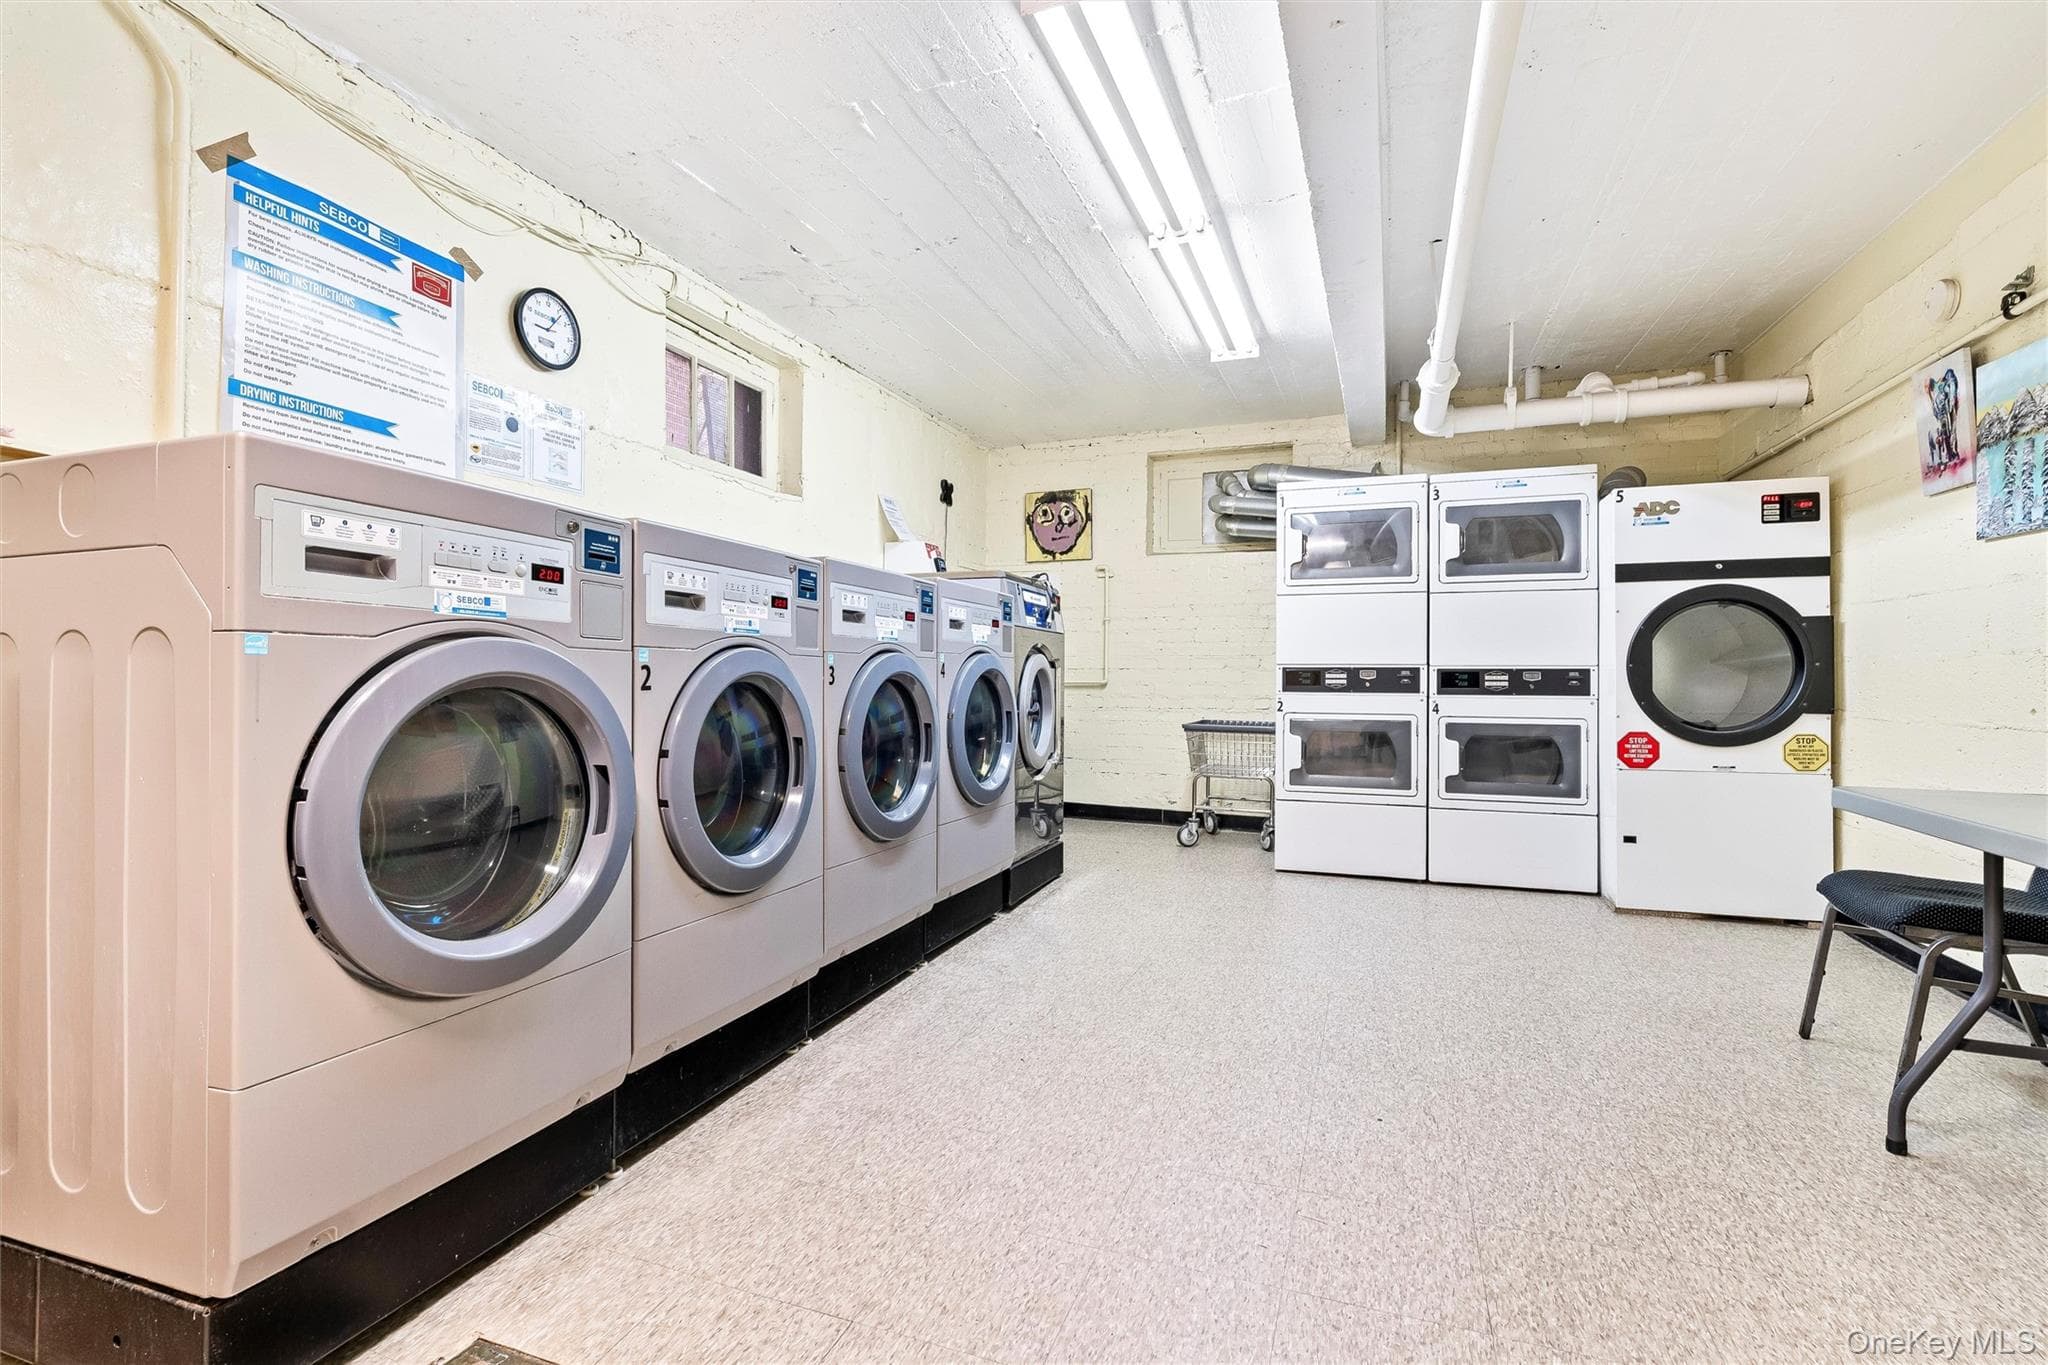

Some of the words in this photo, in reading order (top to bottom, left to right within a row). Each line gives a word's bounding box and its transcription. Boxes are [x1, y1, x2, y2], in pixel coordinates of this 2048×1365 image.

[245, 190, 288, 220] HELPFUL
[290, 210, 319, 234] HINTS
[319, 199, 367, 234] SEBCO
[245, 256, 289, 284] WASHING
[292, 274, 355, 309] INSTRUCTIONS
[472, 380, 500, 398] SEBCO
[240, 383, 276, 404] DRYING
[278, 393, 343, 422] INSTRUCTIONS
[1280, 496, 1285, 507] 1
[1433, 490, 1440, 501] 3
[1615, 489, 1624, 503] 5
[1633, 500, 1680, 517] ADC
[456, 595, 484, 605] SEBCO
[640, 664, 652, 691] 2
[828, 665, 835, 686] 3
[940, 662, 945, 678] 4
[1277, 700, 1283, 712] 2
[1432, 703, 1439, 714] 4
